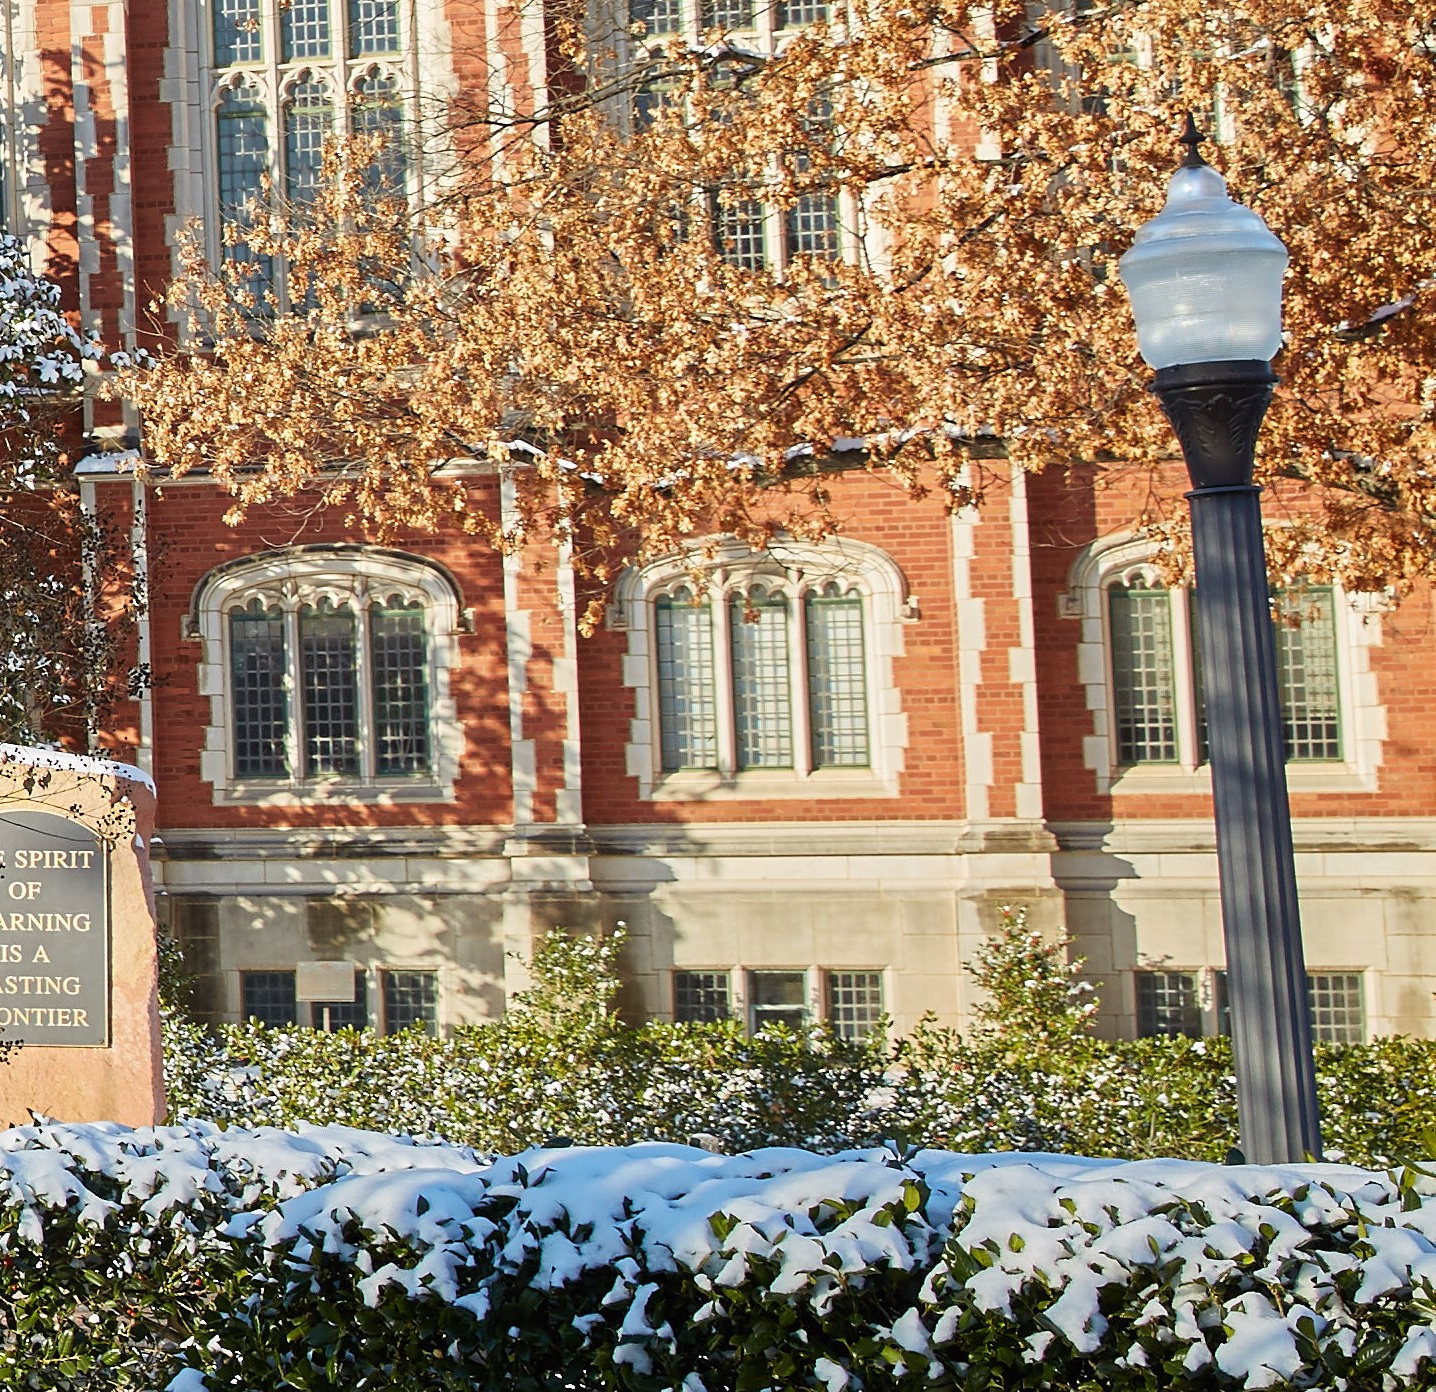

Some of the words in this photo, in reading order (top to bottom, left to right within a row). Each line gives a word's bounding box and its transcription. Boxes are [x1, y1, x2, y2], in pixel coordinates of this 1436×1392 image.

[14, 849, 94, 869] SPIRIT
[8, 881, 42, 900] OF
[0, 944, 23, 963] IS
[32, 944, 51, 963] A
